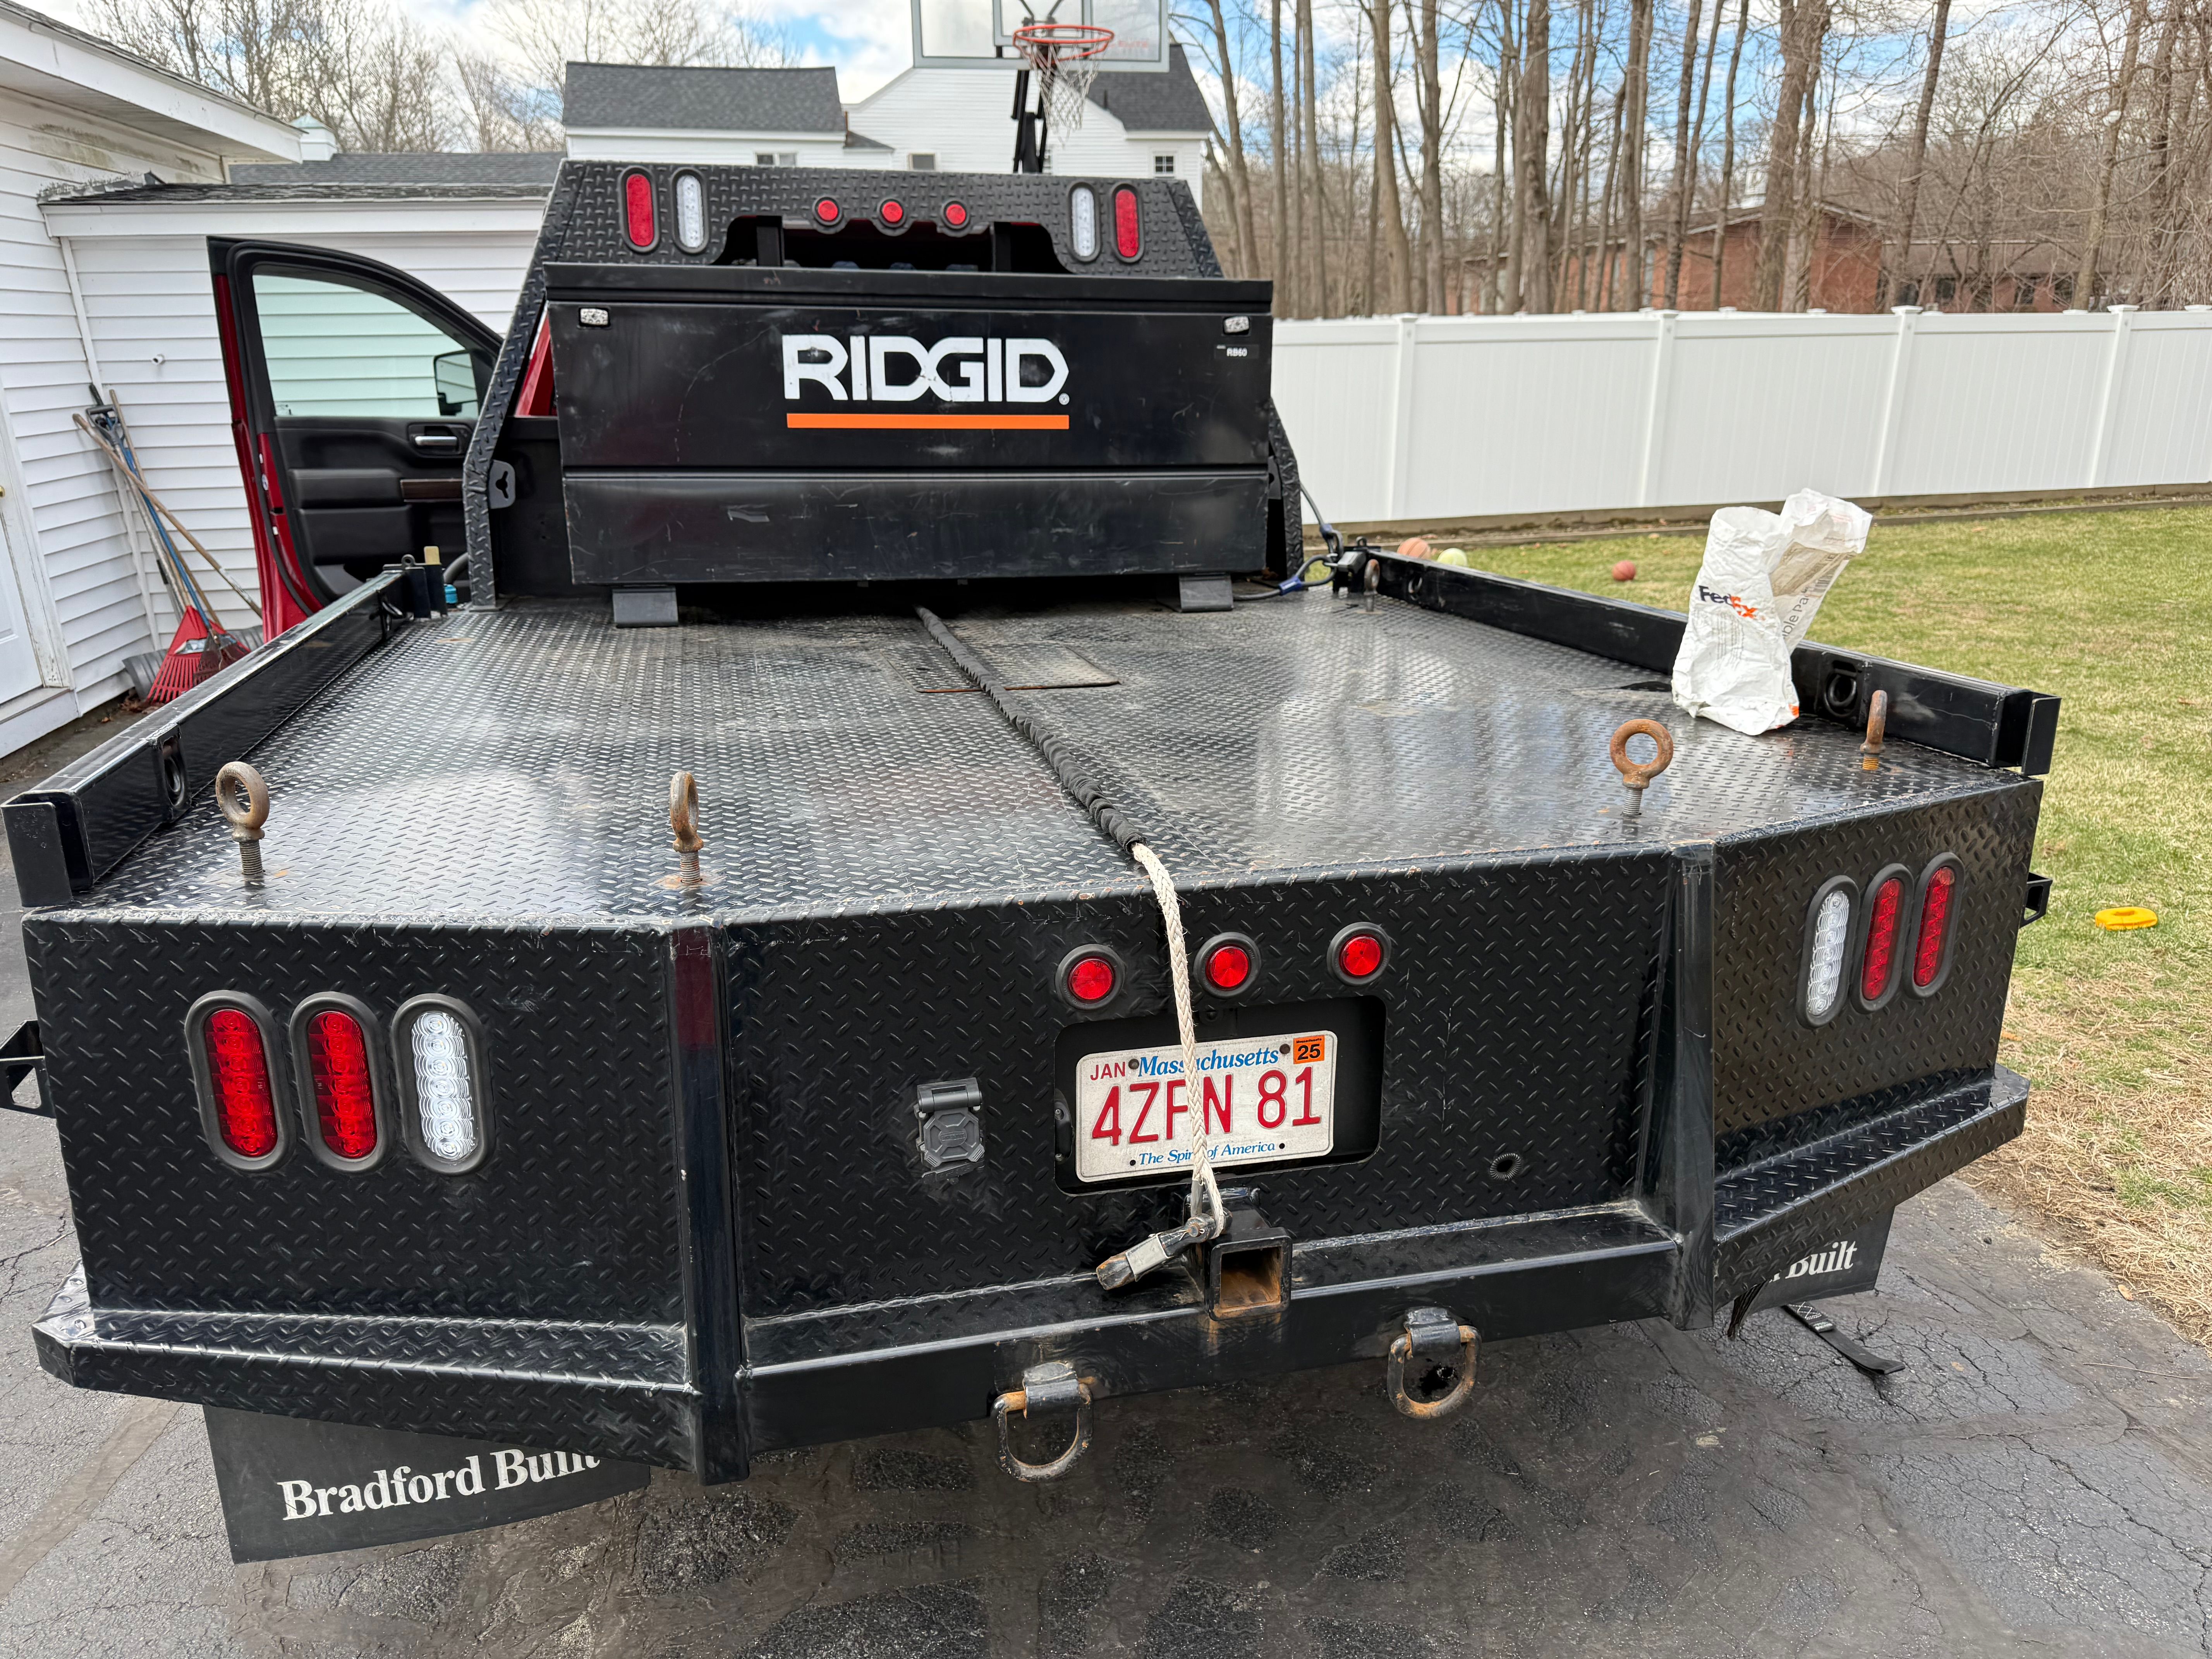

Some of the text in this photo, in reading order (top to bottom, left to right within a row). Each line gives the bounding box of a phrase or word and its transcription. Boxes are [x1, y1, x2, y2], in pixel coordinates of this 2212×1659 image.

[782, 334, 1069, 402] RIDGID
[1698, 585, 1759, 619] FedEx
[1297, 1043, 1321, 1060] 25
[1090, 1061, 1126, 1081] JAN
[1091, 1066, 1321, 1146] 4ZFN 81
[1139, 1142, 1275, 1165] The Spir of America
[277, 1456, 486, 1521] Bradford
